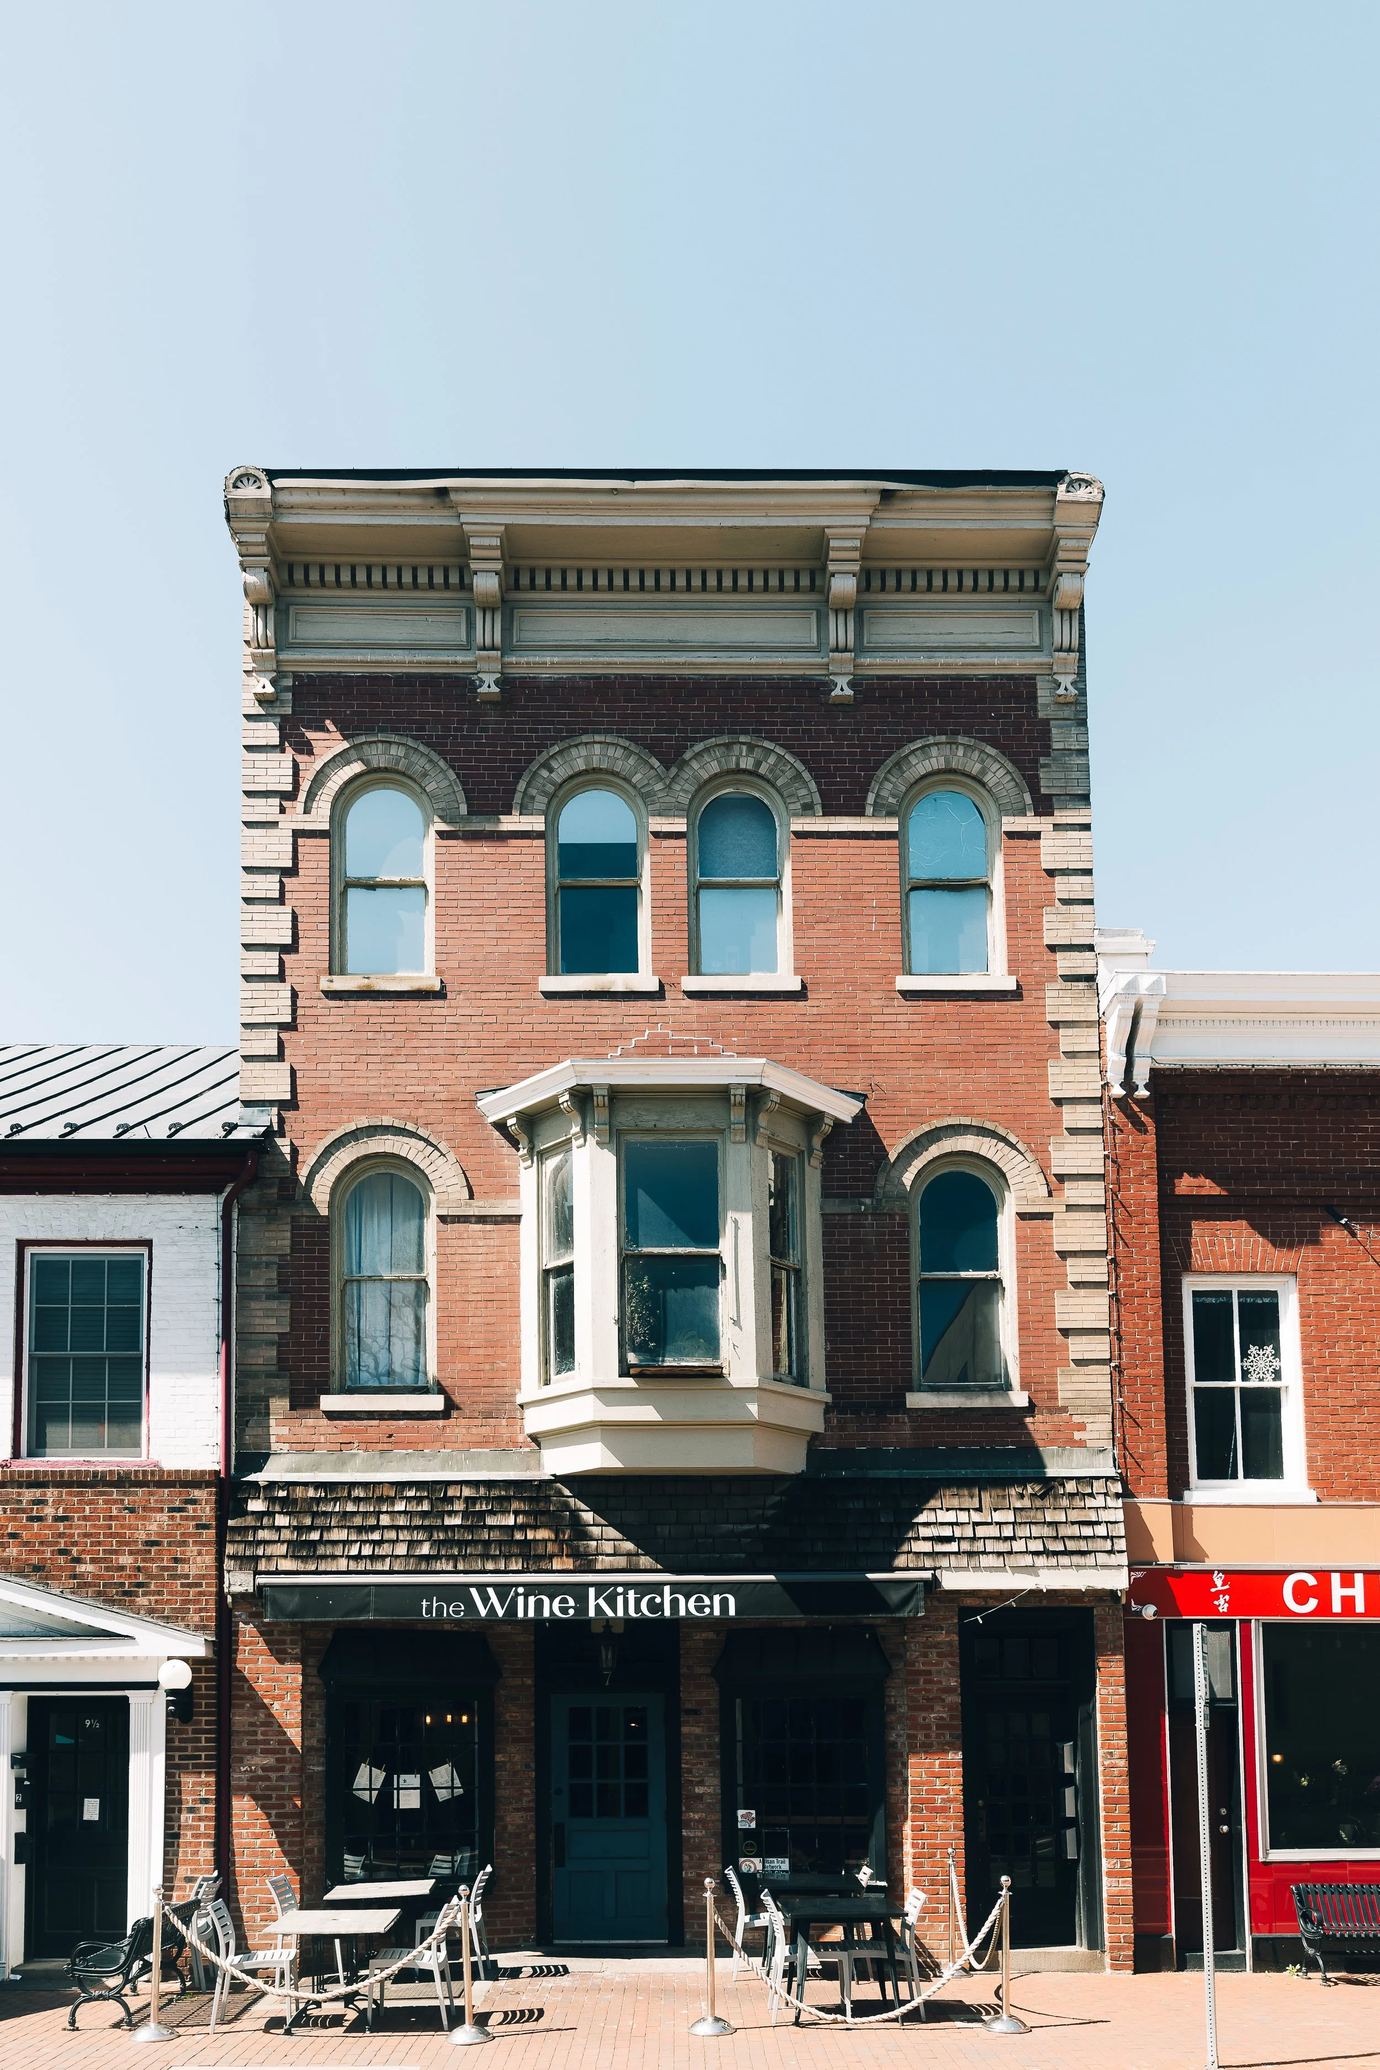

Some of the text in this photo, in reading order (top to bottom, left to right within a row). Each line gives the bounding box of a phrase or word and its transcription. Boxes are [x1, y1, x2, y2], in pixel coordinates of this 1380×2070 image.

[421, 1585, 736, 1618] the Wine Kitchen
